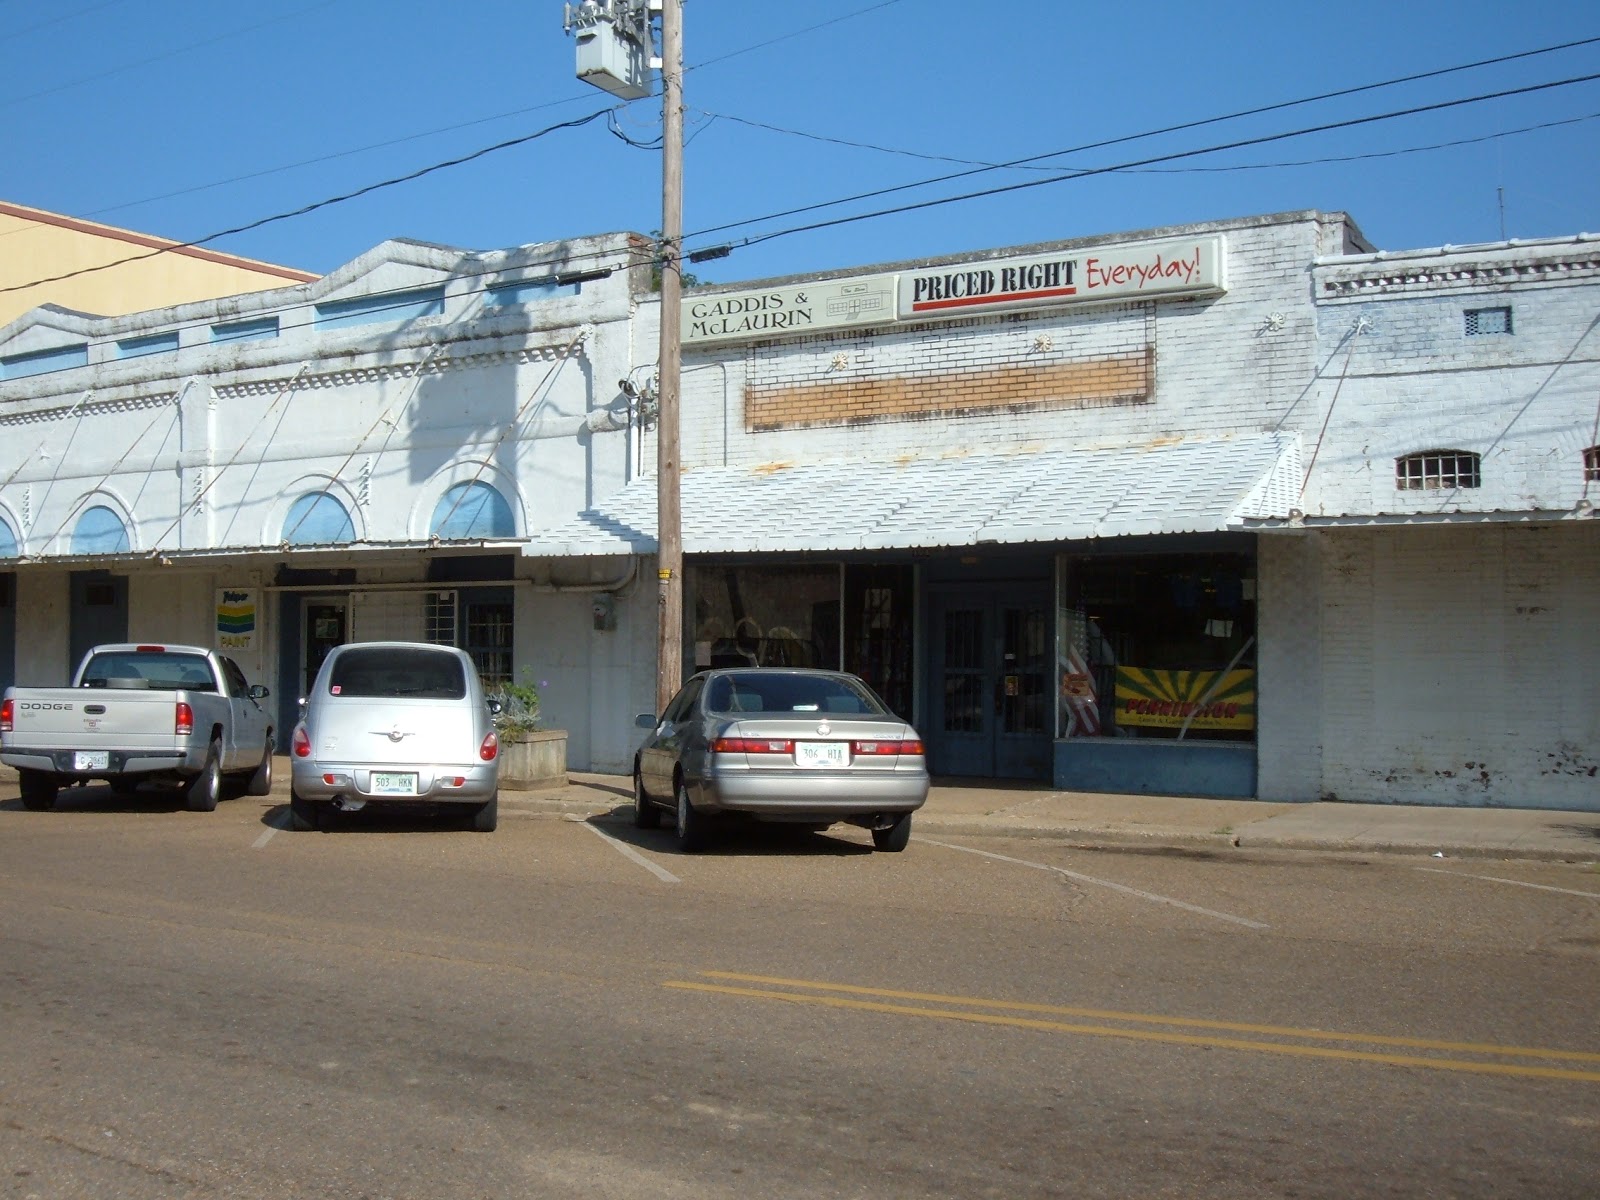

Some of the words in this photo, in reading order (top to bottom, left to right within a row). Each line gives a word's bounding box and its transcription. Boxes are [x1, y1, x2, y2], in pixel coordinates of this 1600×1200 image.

[913, 269, 995, 302] PRICED
[1001, 259, 1077, 293] RIGHT
[1087, 246, 1200, 288] Everyday!
[691, 293, 783, 318] GADDIS
[794, 292, 808, 304] &
[689, 308, 813, 338] McLAURIN
[220, 636, 250, 648] PAINT
[20, 702, 73, 711] DODGE
[802, 748, 819, 759] 306
[375, 777, 390, 787] 503
